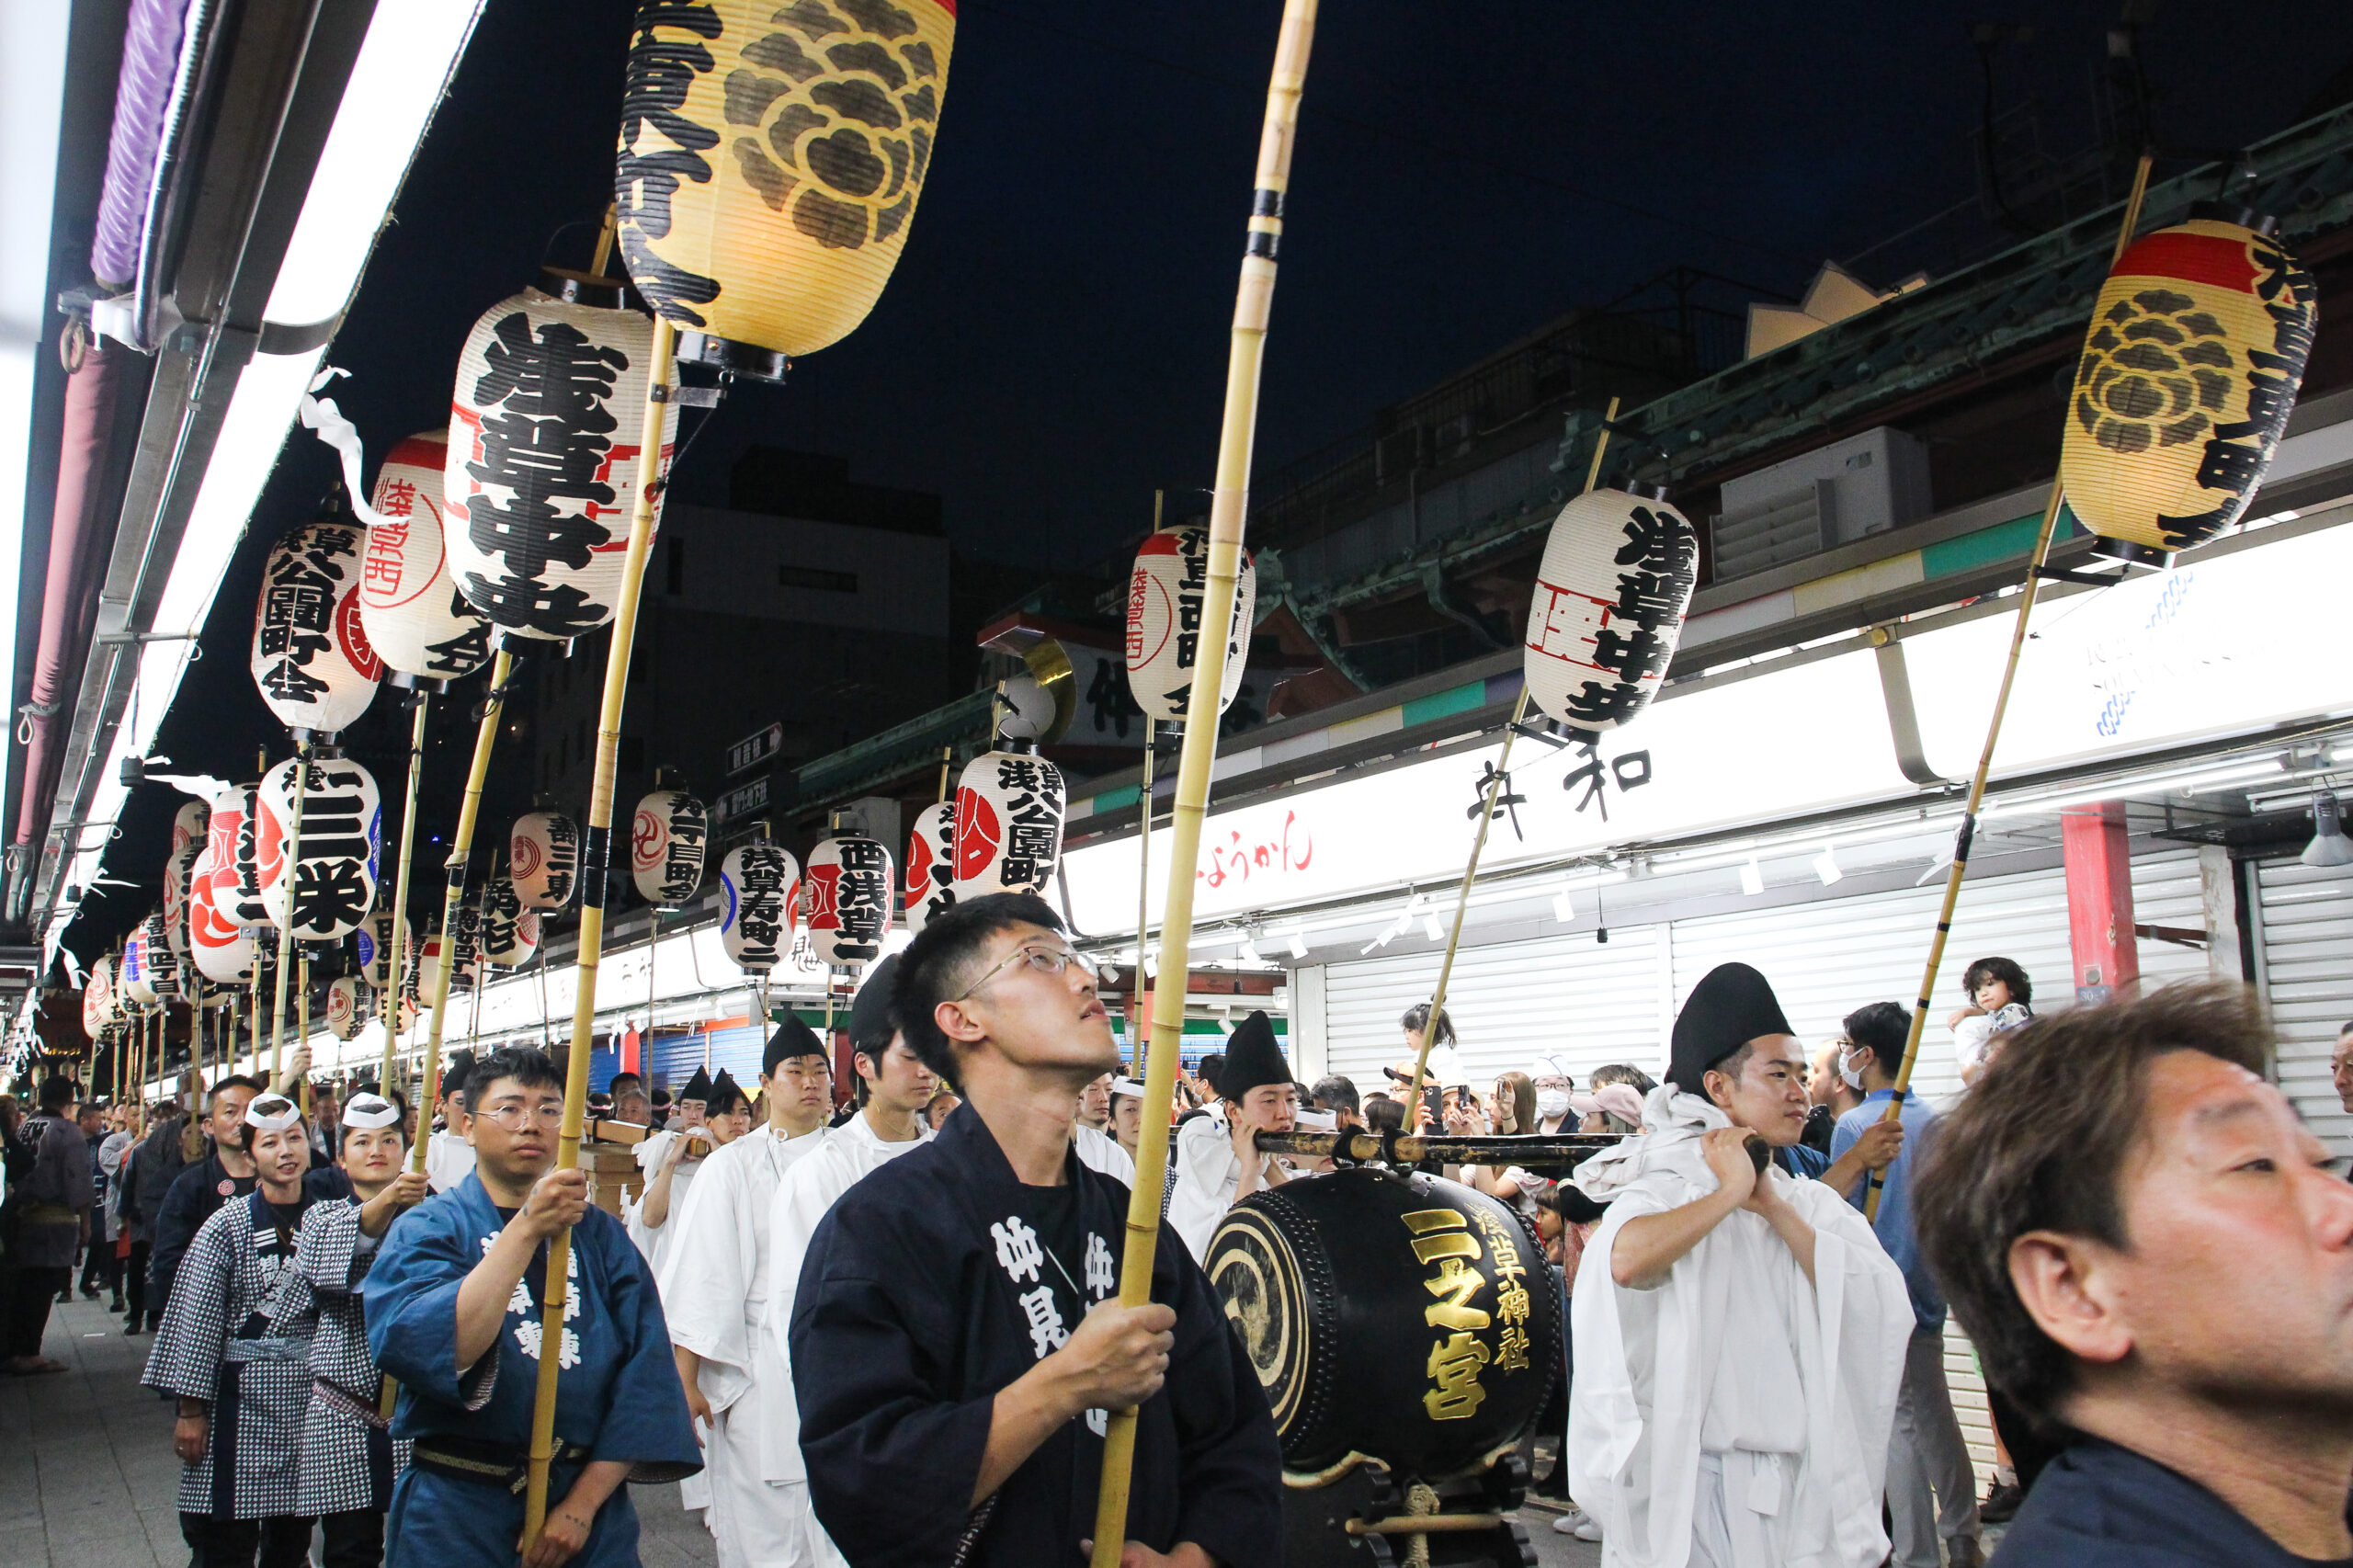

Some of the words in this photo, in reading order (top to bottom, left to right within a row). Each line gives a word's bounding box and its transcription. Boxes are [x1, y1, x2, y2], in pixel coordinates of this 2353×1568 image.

[997, 759, 1064, 897] 浅草公園町
[832, 839, 887, 962] 西浅草一
[1464, 1202, 1531, 1370] 浅草神社
